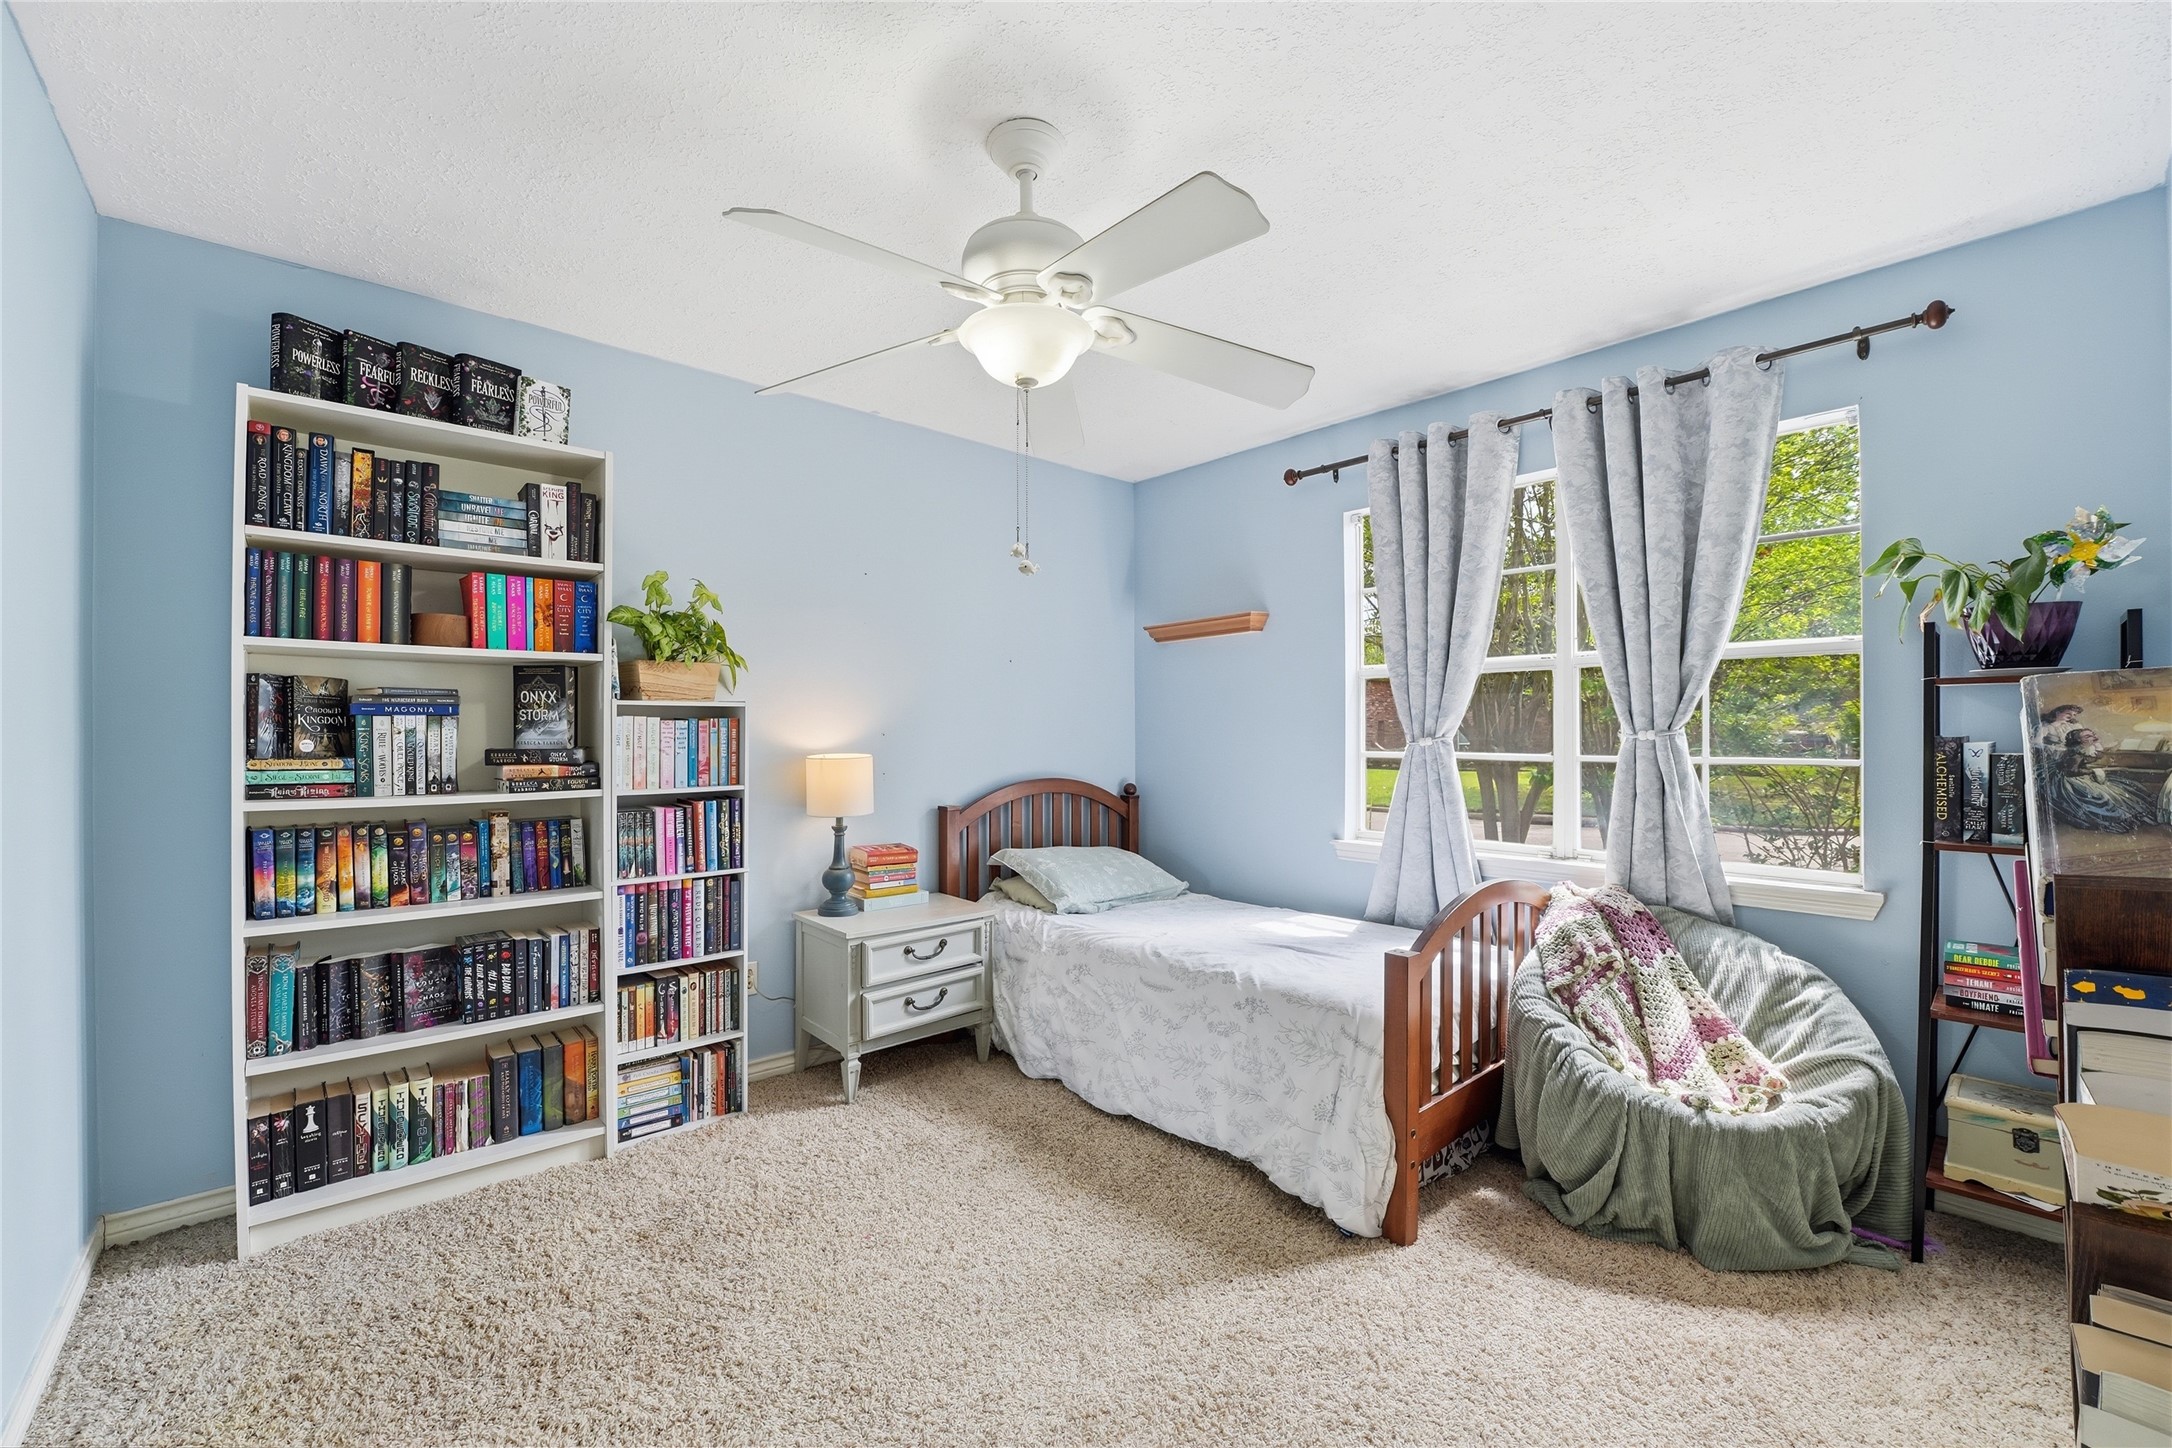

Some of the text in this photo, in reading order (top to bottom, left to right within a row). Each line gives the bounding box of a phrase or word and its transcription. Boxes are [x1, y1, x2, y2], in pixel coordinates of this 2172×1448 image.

[271, 323, 281, 369] POWERLESS
[291, 348, 341, 375] POWERLESS
[359, 361, 397, 386] FEARFU
[410, 367, 454, 393] RECKLESS
[471, 377, 515, 404] FEARLESS
[528, 394, 563, 412] POWERFUL
[319, 448, 329, 475] DAWN
[257, 456, 267, 511] ROAD BONES
[282, 443, 293, 517] KINGDOM CLAW
[317, 491, 329, 521] NORTH
[542, 493, 564, 501] KING
[494, 528, 505, 536] ME
[383, 705, 435, 713] MAGONIA
[520, 690, 558, 704] ONYX
[297, 713, 348, 733] KINGDOM
[518, 708, 561, 722] STORM
[357, 731, 370, 784] KING SCARS
[1935, 752, 1948, 821] ALCHEMISED
[676, 811, 685, 839] WILDER
[694, 917, 704, 950] QUEEN
[1953, 954, 2000, 967] DEAR DEBBIE
[415, 976, 449, 990] TOUCH
[487, 969, 498, 992] ALL IN
[501, 962, 513, 995] BAD BLOOD
[1965, 978, 1994, 989] TENANT
[418, 991, 447, 1002] CHAOS
[1959, 989, 2000, 1001] BOYFRIEND
[1971, 1001, 2000, 1012] INMATE
[356, 1102, 369, 1165] SCYTHE
[395, 1091, 406, 1161] THUNDERHEAD
[416, 1087, 429, 1155] THE TOLL
